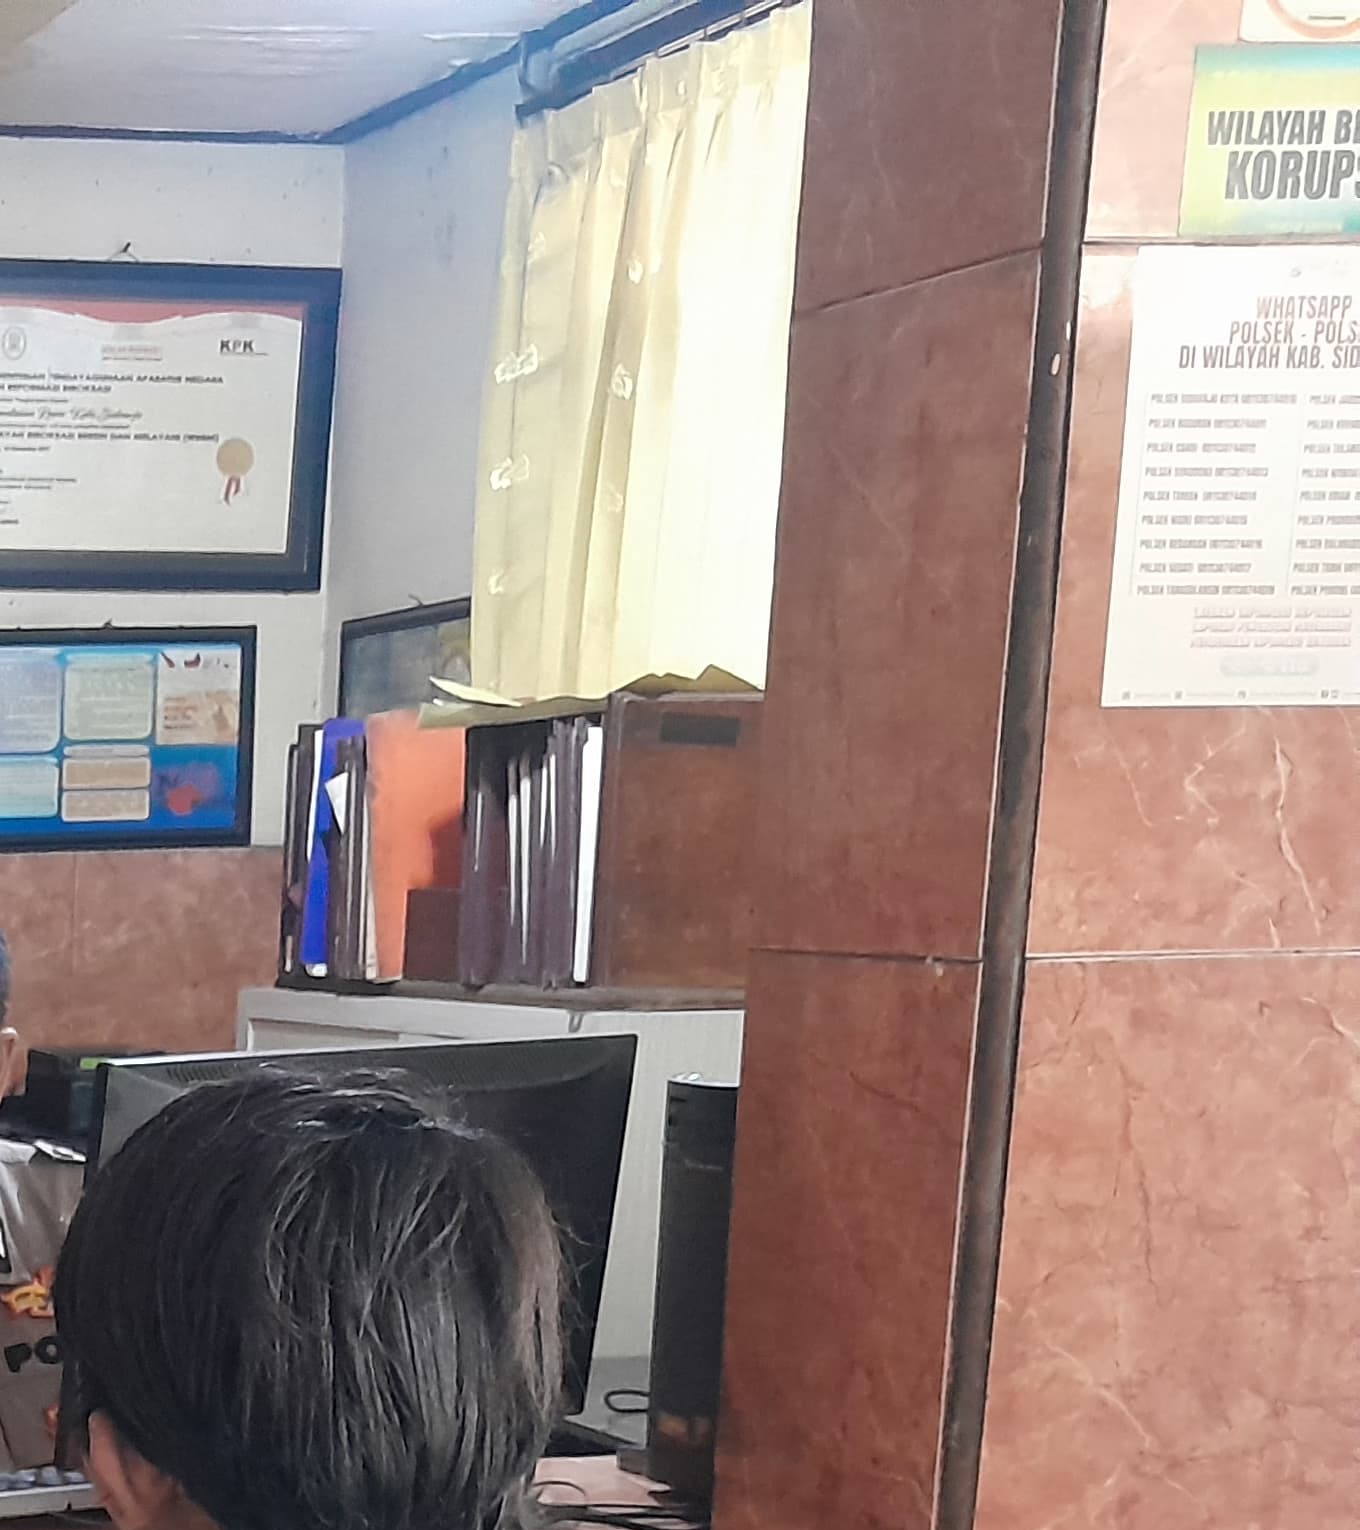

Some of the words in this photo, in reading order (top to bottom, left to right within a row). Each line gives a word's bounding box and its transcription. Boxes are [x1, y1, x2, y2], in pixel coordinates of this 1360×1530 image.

[1208, 110, 1326, 145] WILAYAH
[1256, 295, 1353, 319] WHATSAPP
[1229, 320, 1294, 344] POLSEK
[220, 340, 255, 353] KPK
[1179, 345, 1196, 368] DI
[1203, 345, 1280, 368] WILAYAH
[1286, 345, 1325, 368] KAB.
